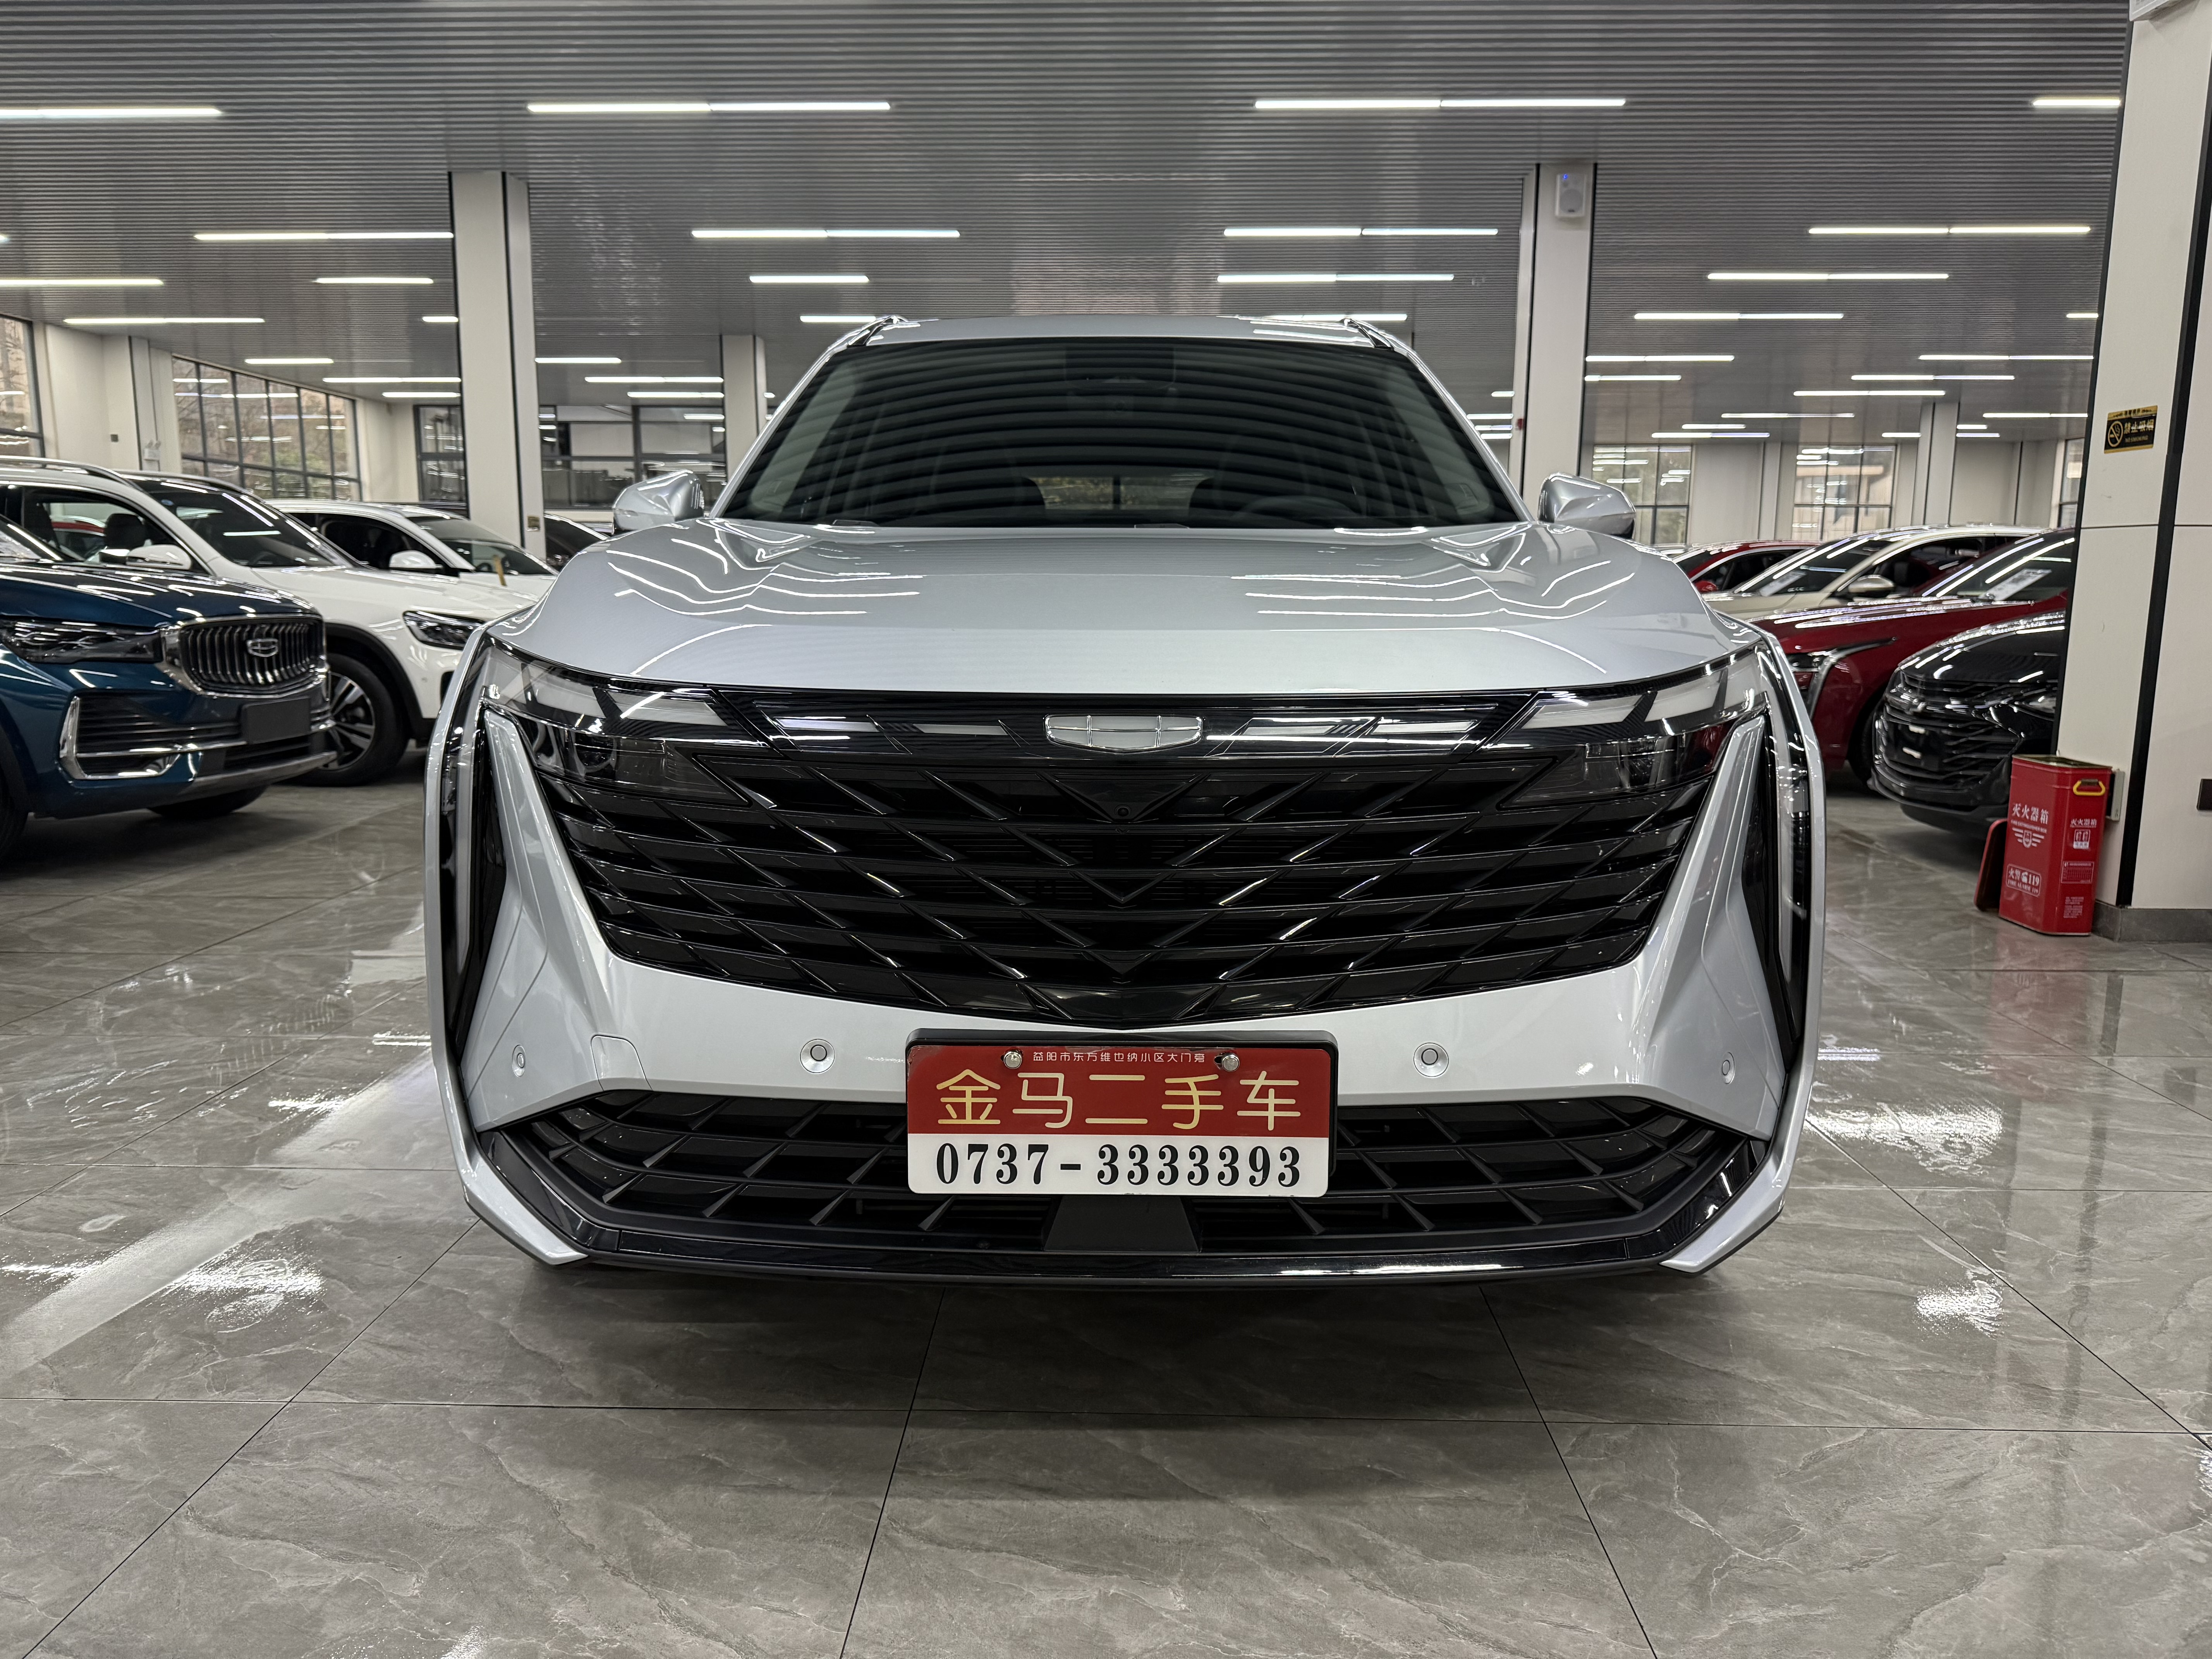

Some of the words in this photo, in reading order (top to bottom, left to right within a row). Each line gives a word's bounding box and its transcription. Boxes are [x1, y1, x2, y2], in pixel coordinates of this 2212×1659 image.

[2012, 803, 2049, 824] 灭火器箱
[1033, 1052, 1205, 1063] 益阳市东方维也纳小区大门旁
[936, 1069, 1301, 1131] 金马二手车
[936, 1143, 1300, 1187] 0737-3333393
